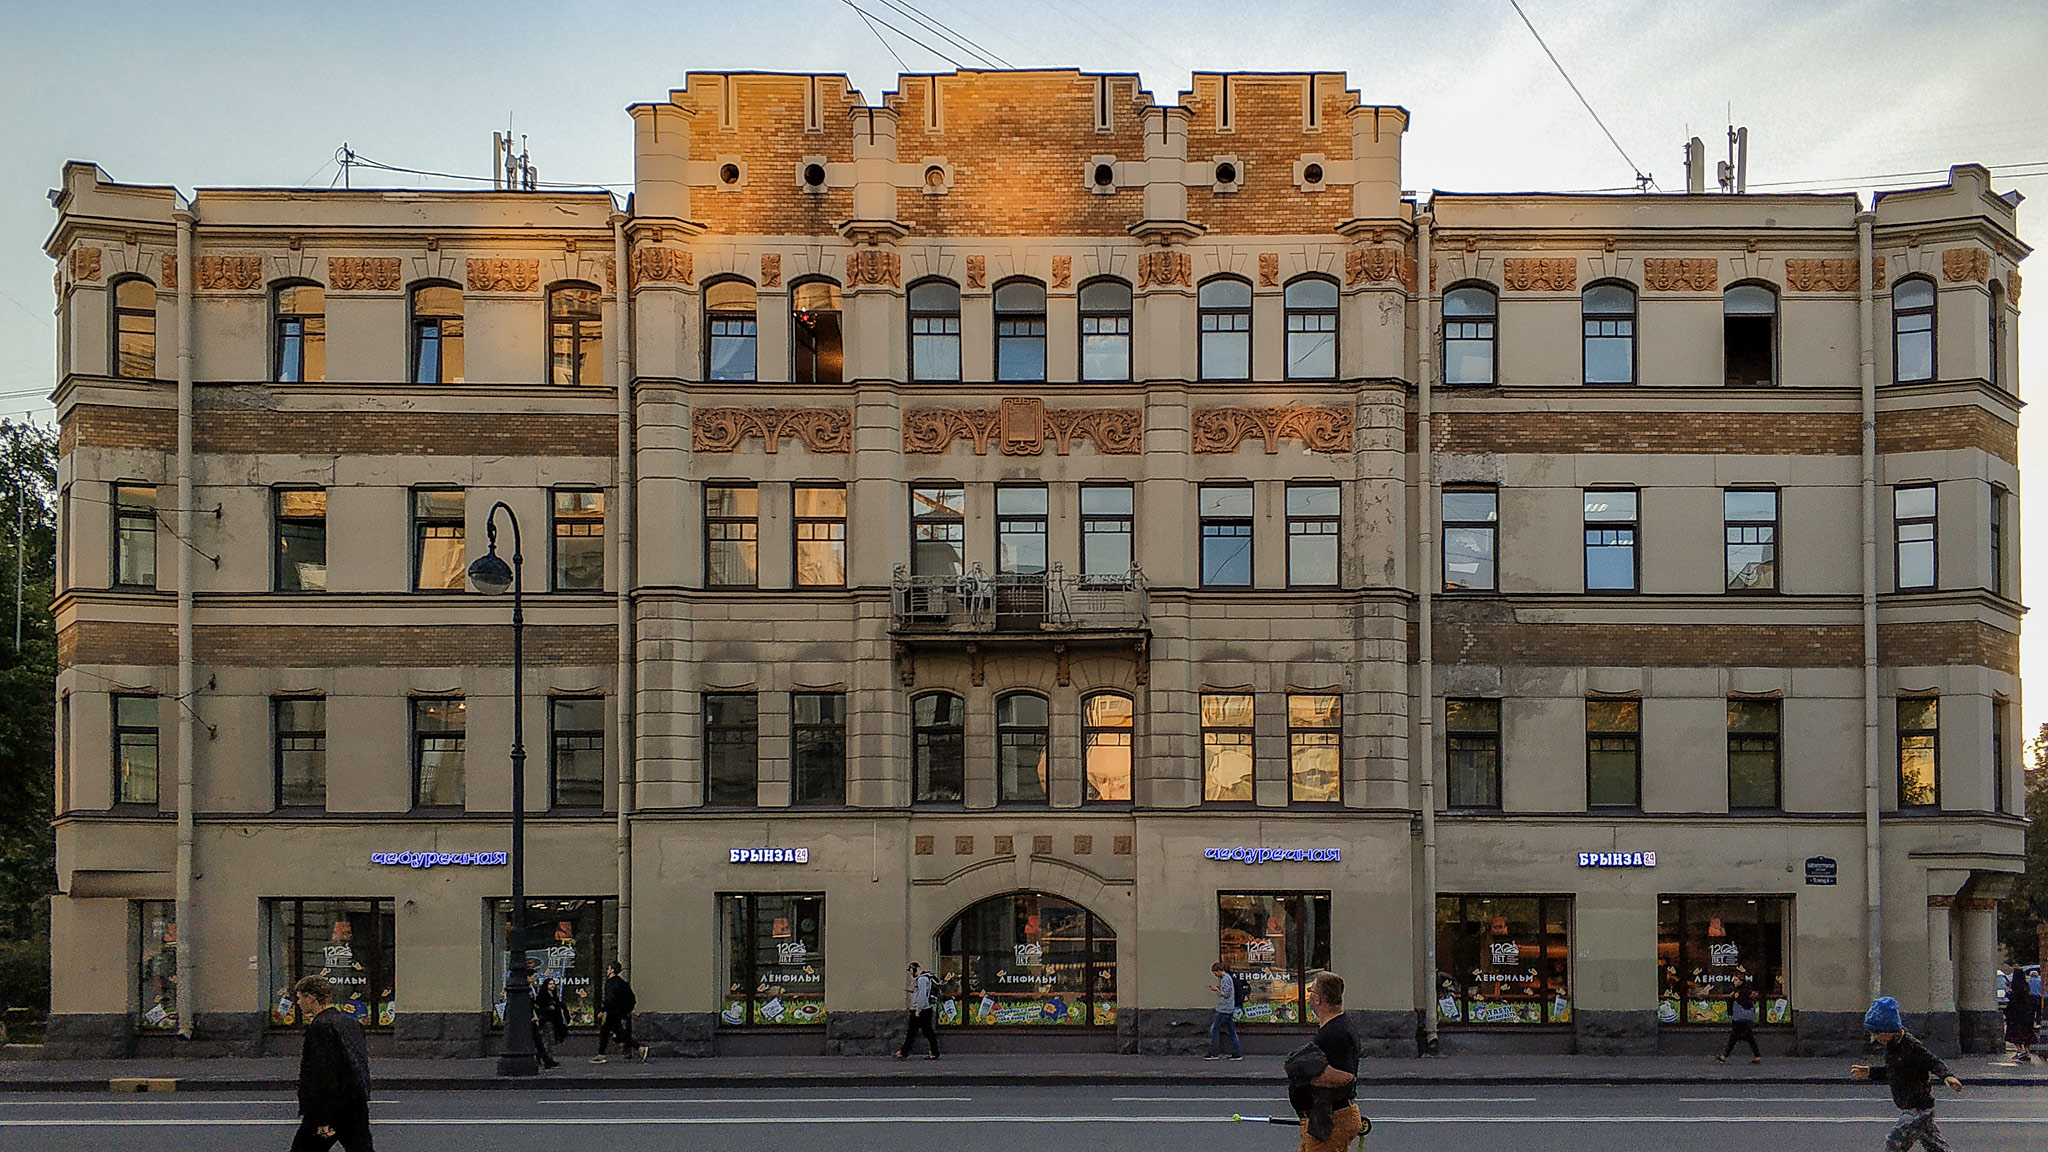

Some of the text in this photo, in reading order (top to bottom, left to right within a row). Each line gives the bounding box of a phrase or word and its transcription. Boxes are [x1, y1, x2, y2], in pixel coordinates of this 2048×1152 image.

[371, 850, 507, 868] чебуречная
[729, 849, 794, 862] БРЫНЗА
[1204, 846, 1340, 864] чебуречная
[1579, 853, 1643, 866] БРЫНЗА
[778, 955, 792, 963] ЛЕТ
[1248, 953, 1261, 961] ЛЕТ
[760, 974, 820, 982] ЛЕНФИЛЬМ
[999, 976, 1057, 984] ЛЕНФИЛЬМ
[1475, 974, 1533, 982] ЛЕНФИЛЬМ
[1694, 975, 1753, 983] ЛЕНФИЛМ
[1487, 1006, 1512, 1015] TASTY
